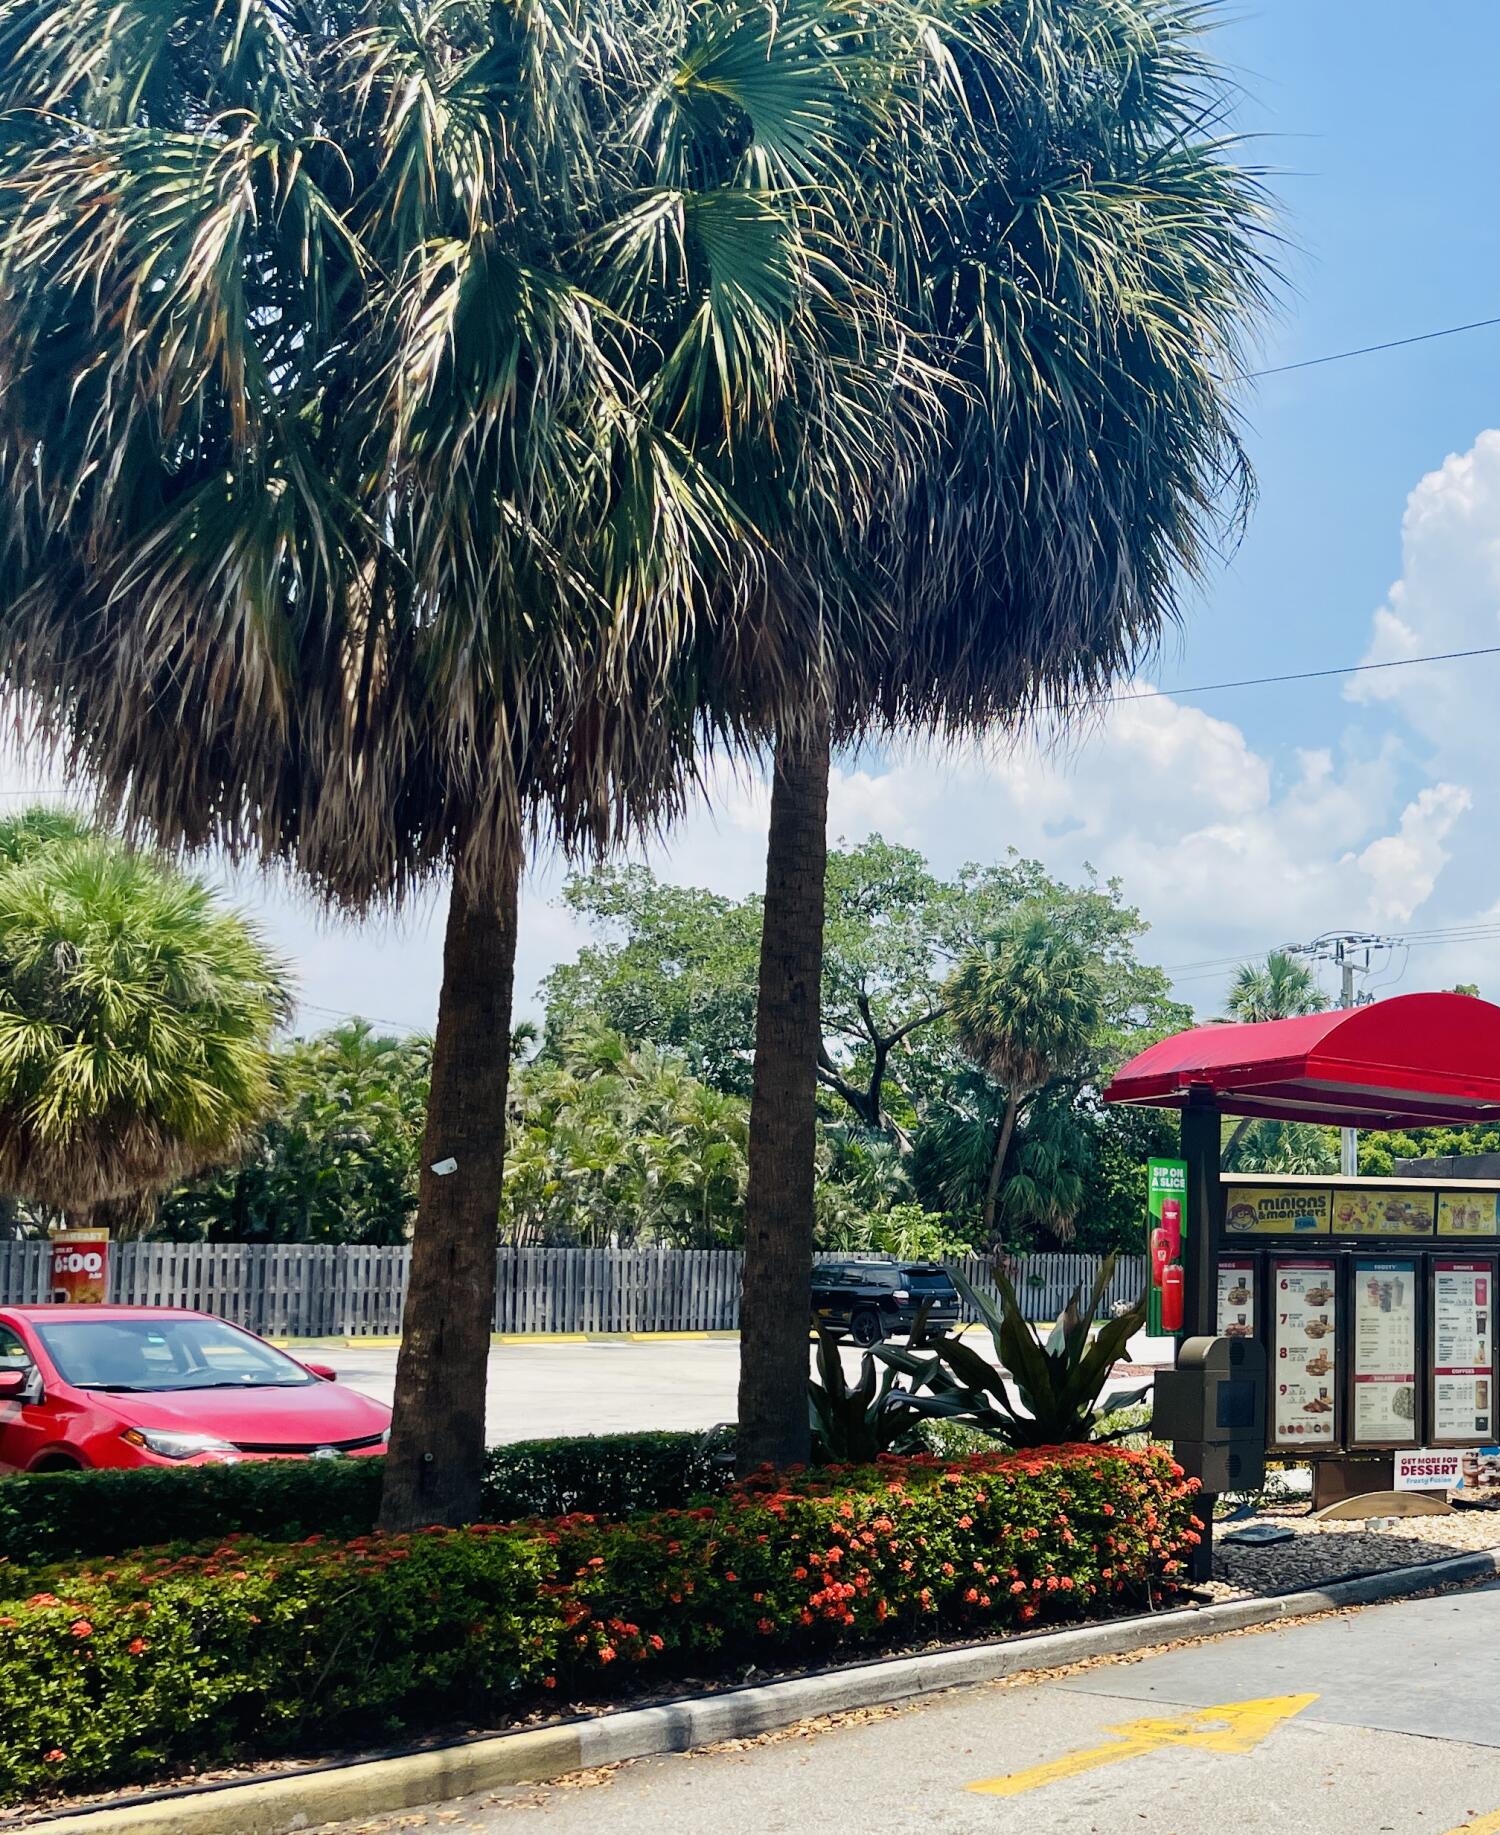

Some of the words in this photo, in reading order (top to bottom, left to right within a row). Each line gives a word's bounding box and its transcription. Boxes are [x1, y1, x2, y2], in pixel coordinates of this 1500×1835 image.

[1154, 1167, 1168, 1178] SIP
[1170, 1168, 1183, 1178] ON
[1152, 1178, 1159, 1188] A
[1160, 1178, 1185, 1188] SLICE
[1258, 1196, 1326, 1210] minions
[1266, 1208, 1326, 1219] monsters
[55, 1253, 102, 1273] 6:00
[1280, 1279, 1288, 1290] 6
[1280, 1314, 1288, 1324] 7
[1280, 1347, 1287, 1358] 8
[1280, 1384, 1287, 1395] 9
[1401, 1464, 1458, 1476] DESSERT
